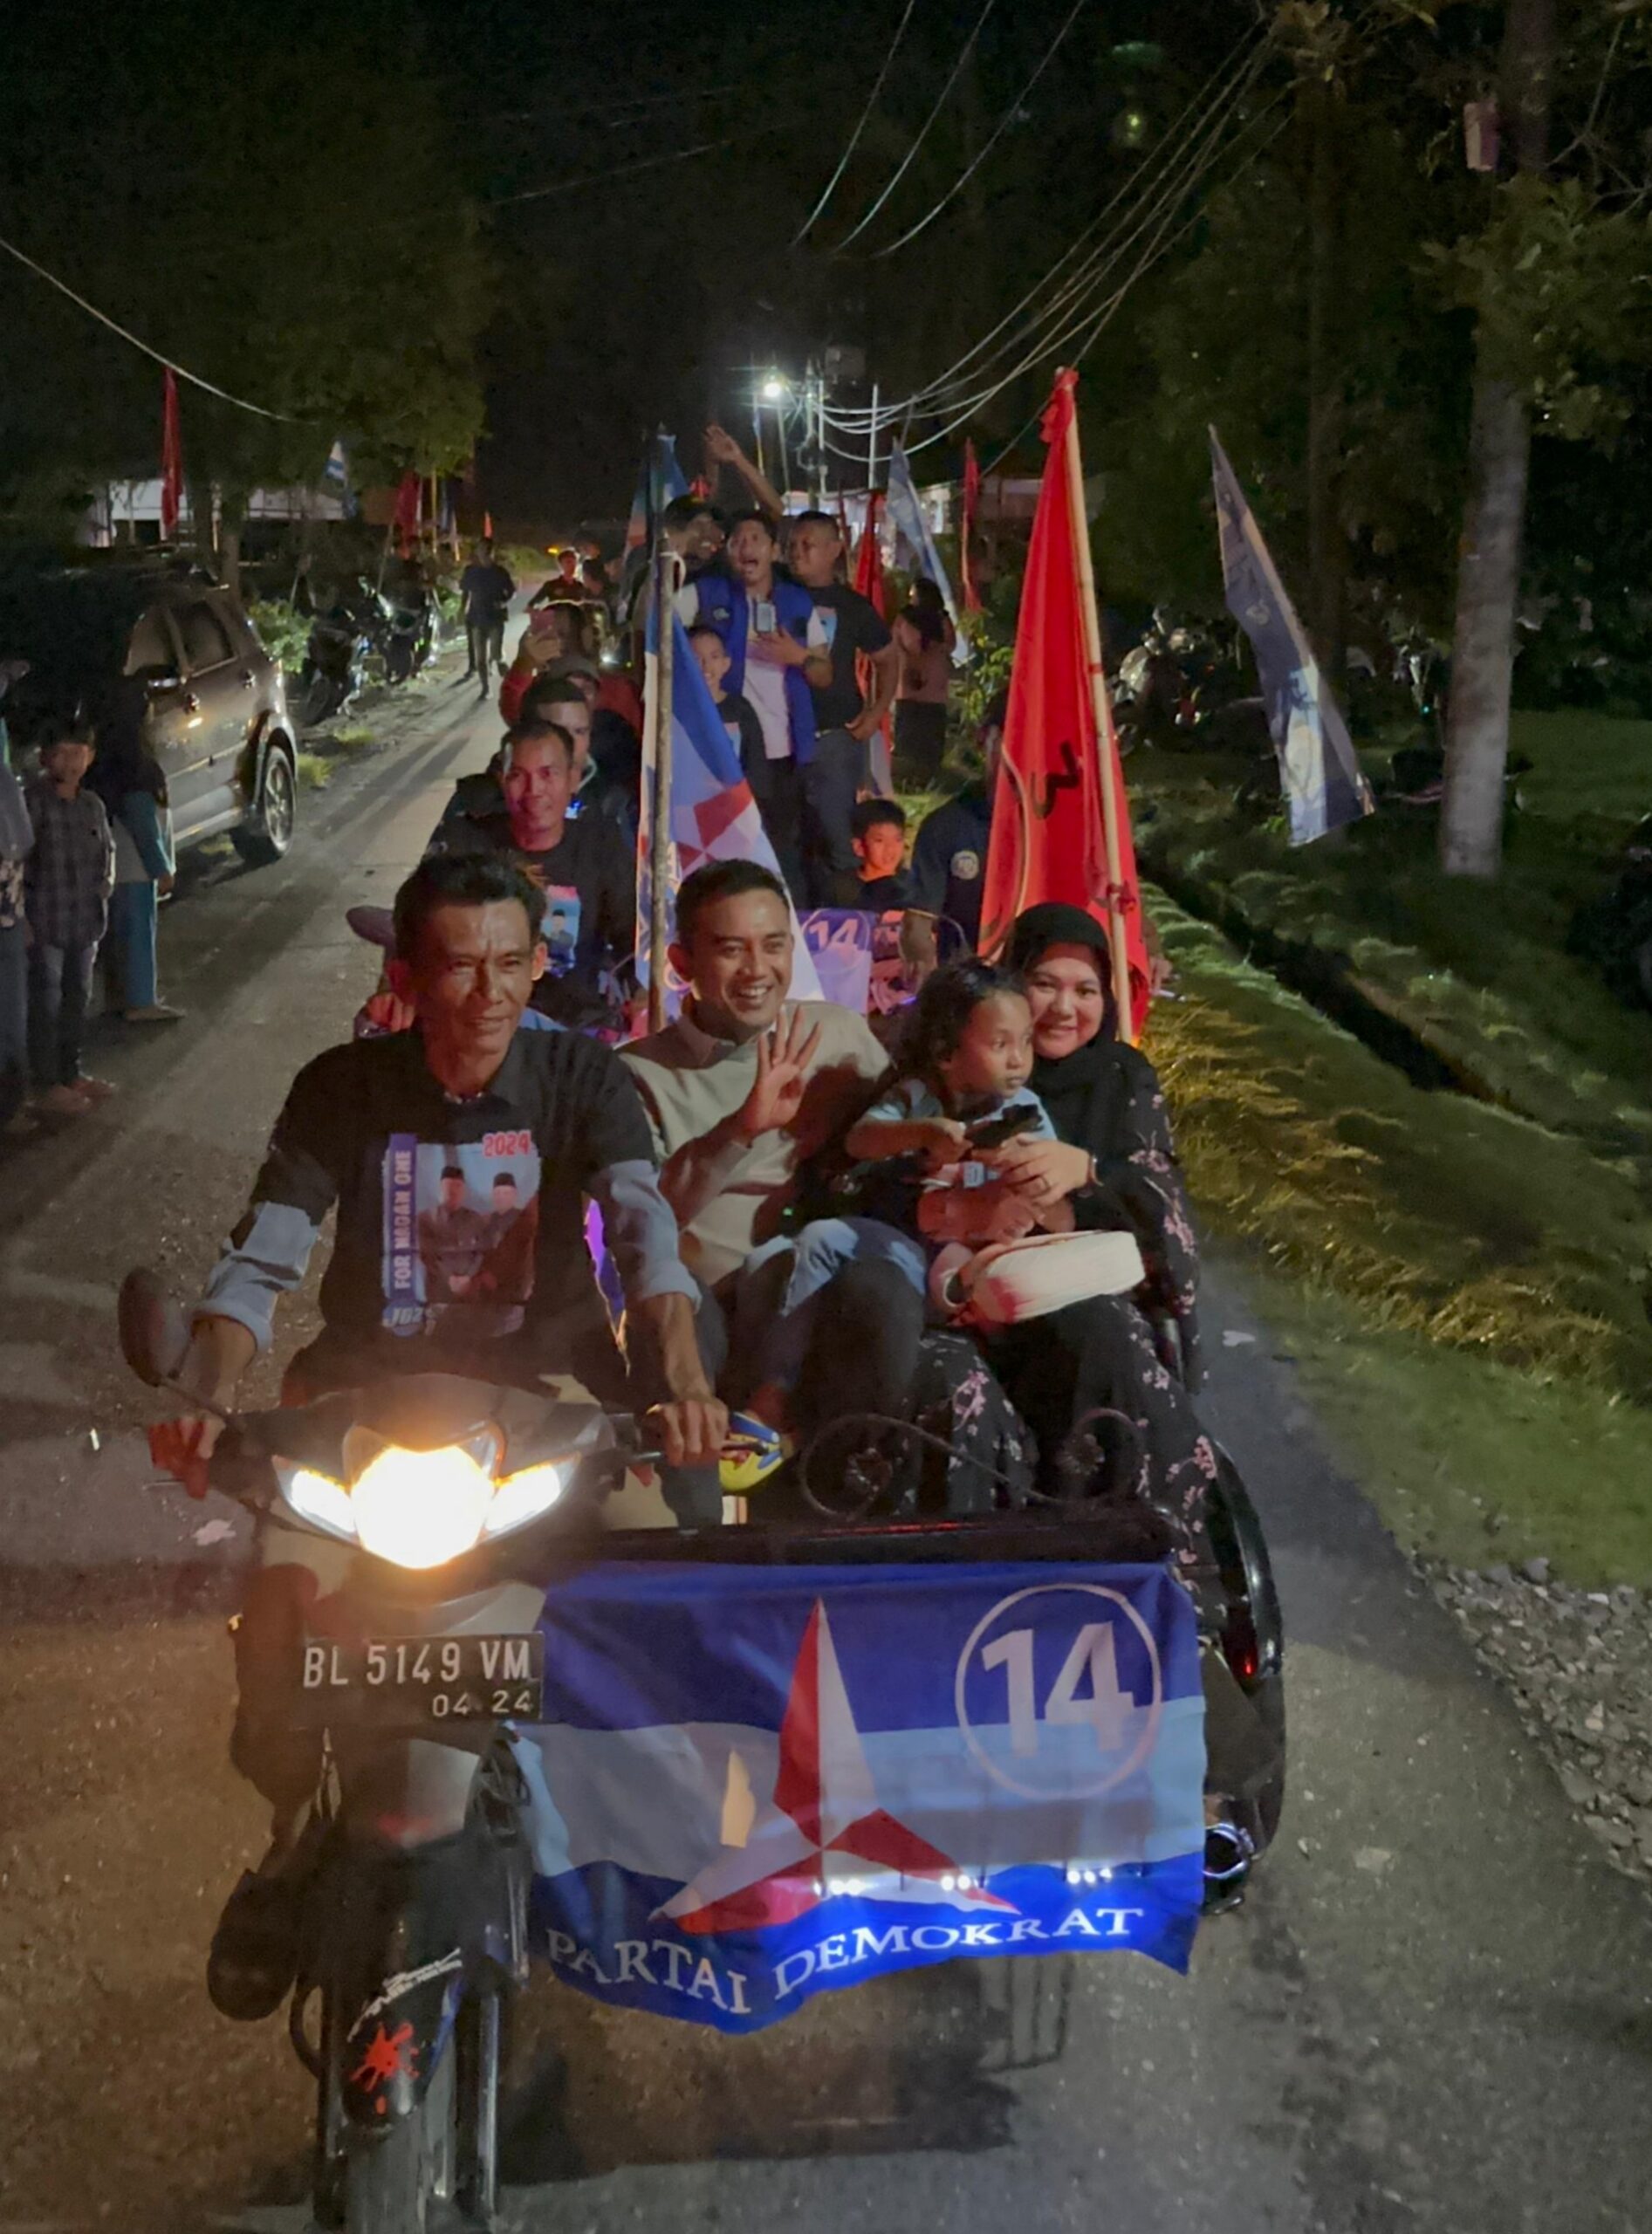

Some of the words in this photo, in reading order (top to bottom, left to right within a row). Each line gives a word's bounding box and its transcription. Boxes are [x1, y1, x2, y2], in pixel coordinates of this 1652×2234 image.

[808, 918, 859, 960] 14
[483, 1128, 531, 1157] 2024
[394, 1150, 412, 1185] ONE
[394, 1255, 412, 1290] FOR
[303, 1646, 348, 1688] BL
[367, 1641, 461, 1685] 5149
[480, 1640, 530, 1681] VM
[432, 1693, 470, 1717] 04
[491, 1689, 533, 1713] 24
[982, 1620, 1135, 1758] 14
[545, 1928, 751, 2014] PARTAI
[773, 1907, 1143, 2000] DEMOKRAT
